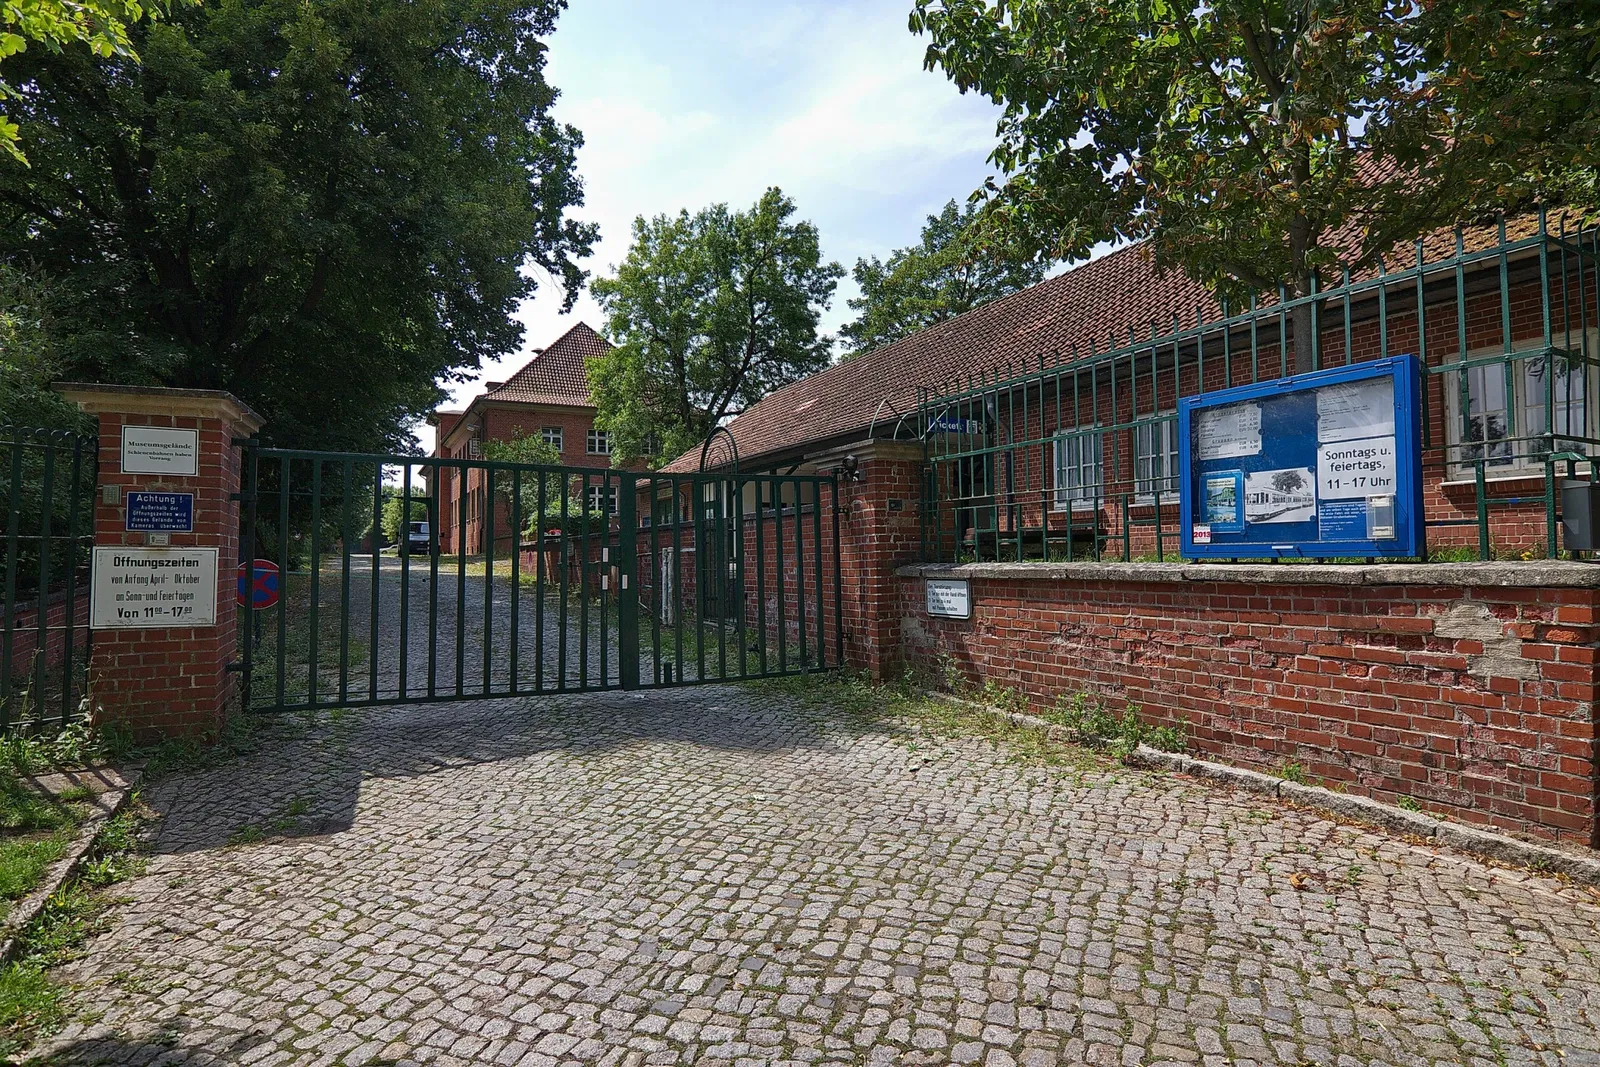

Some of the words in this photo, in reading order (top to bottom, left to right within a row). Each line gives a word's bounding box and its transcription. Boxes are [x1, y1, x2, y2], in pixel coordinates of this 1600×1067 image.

[128, 441, 192, 449] Museumsgelände
[1325, 448, 1376, 460] Sonntags
[1330, 460, 1386, 472] feiertags,
[1370, 477, 1391, 486] Uhr
[136, 494, 175, 504] Achtung
[113, 554, 199, 569] Öffnungszeiten
[111, 576, 123, 584] von
[124, 574, 148, 586] Anfang
[174, 573, 200, 584] Oktober
[118, 608, 139, 618] Von
